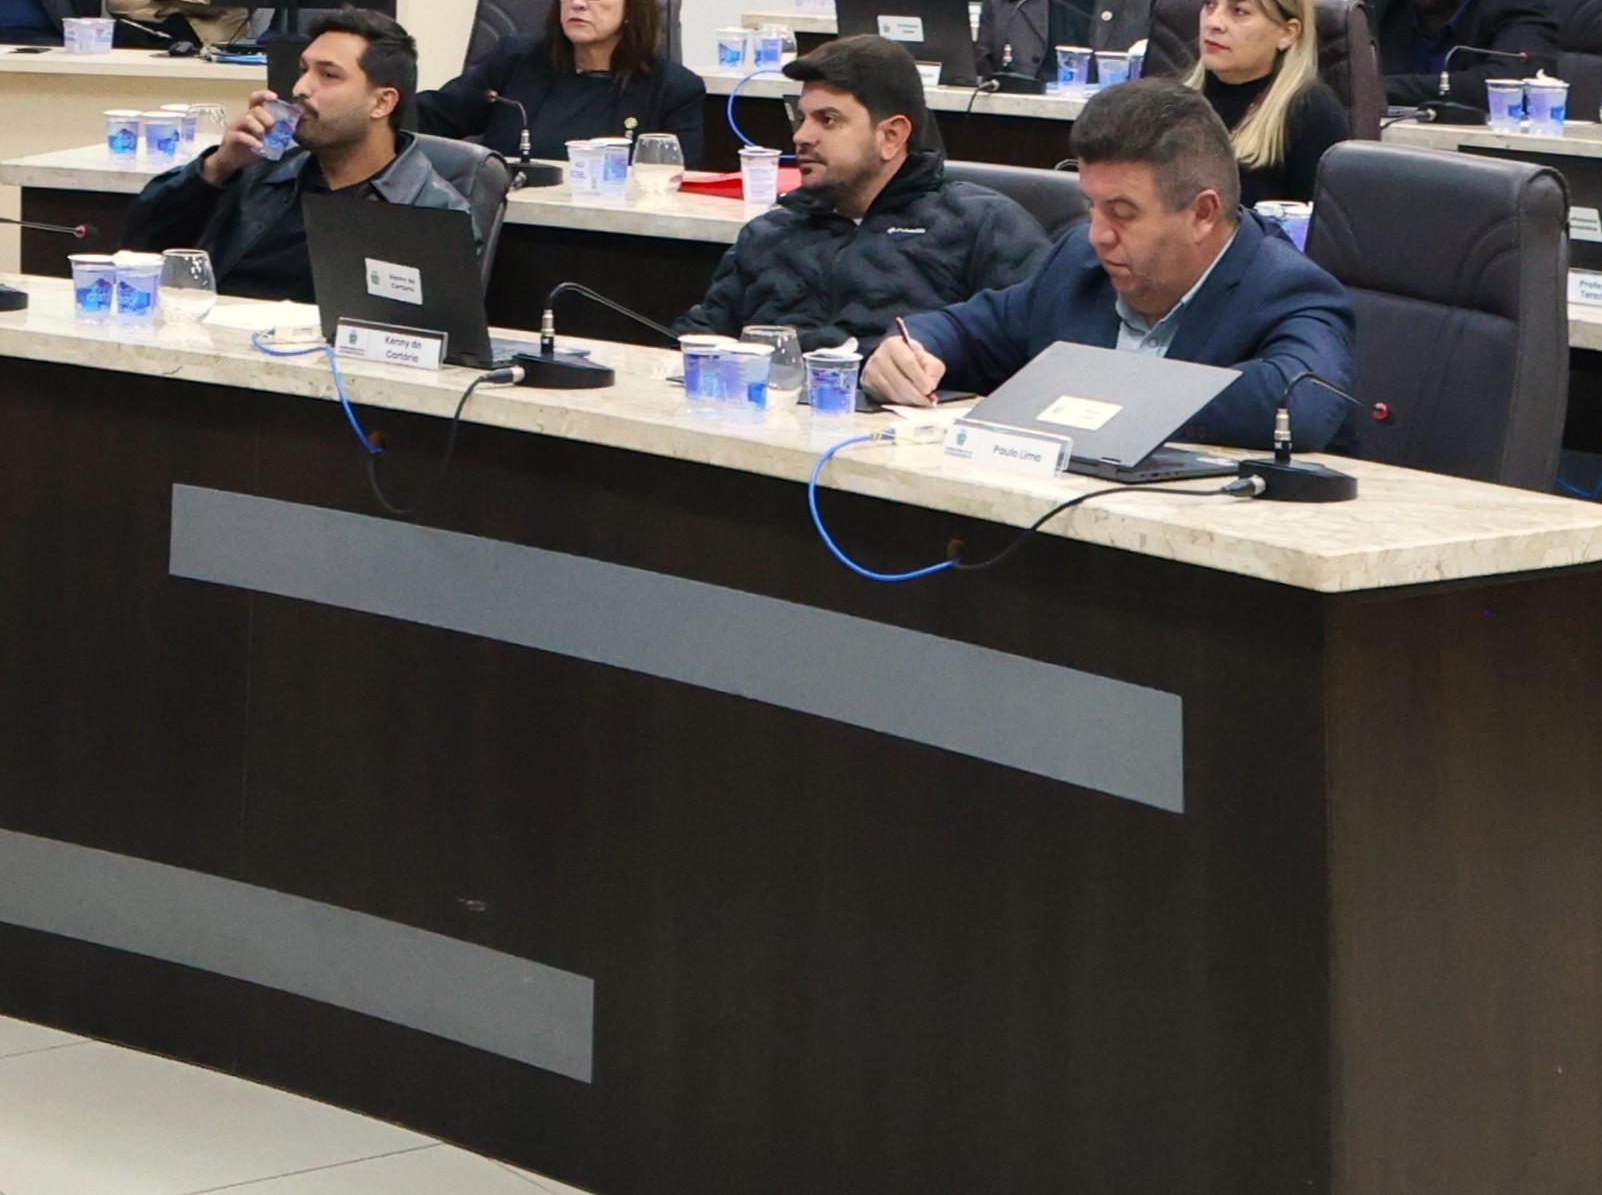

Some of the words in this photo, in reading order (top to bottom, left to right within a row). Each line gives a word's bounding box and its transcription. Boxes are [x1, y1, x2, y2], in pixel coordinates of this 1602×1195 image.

[384, 336, 410, 350] Kenny
[411, 340, 423, 350] do
[385, 349, 420, 363] Cartório
[992, 444, 1019, 459] Paulo
[1019, 448, 1043, 463] Lima
